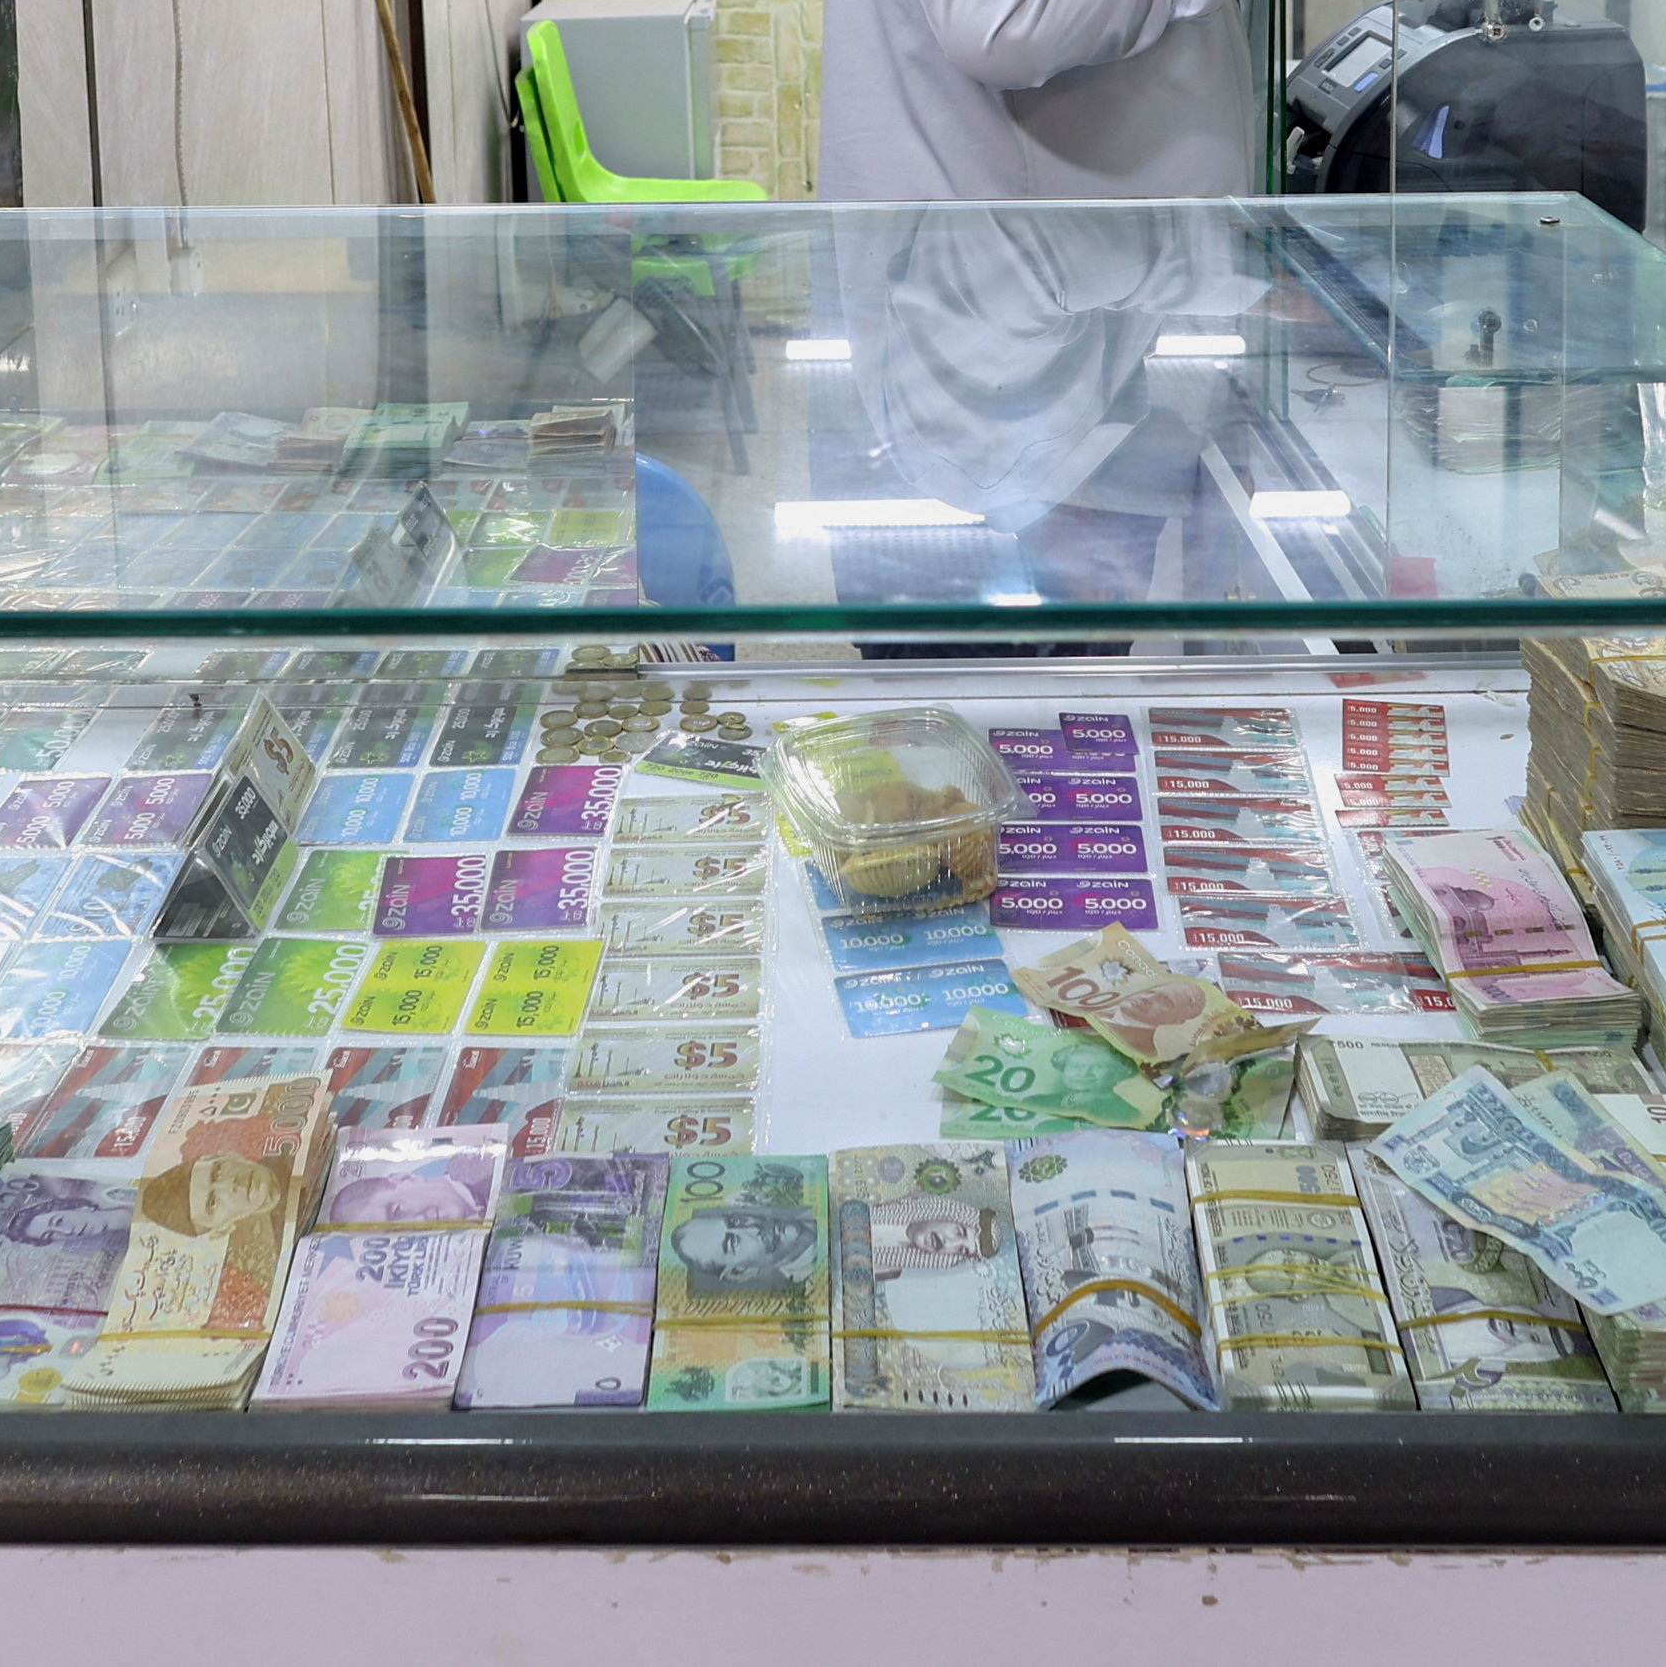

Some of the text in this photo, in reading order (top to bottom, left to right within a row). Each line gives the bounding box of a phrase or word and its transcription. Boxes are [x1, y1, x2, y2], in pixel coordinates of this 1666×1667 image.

[461, 772, 482, 801] 10,000
[1079, 778, 1116, 786] zain
[1075, 793, 1133, 805] 5,000
[450, 806, 472, 837] 10,000
[1082, 826, 1120, 835] zain
[1077, 843, 1137, 856] 5,000
[1090, 880, 1130, 889] zain
[1001, 897, 1064, 910] 5,000
[1084, 897, 1147, 910] 5,000
[413, 944, 443, 981] 15,000
[533, 944, 560, 982] 15,000
[682, 972, 740, 1000] $5
[1046, 965, 1122, 1007] 100
[391, 989, 424, 1027] 15,000
[515, 989, 545, 1028] 15,000
[674, 1040, 738, 1071] $5
[964, 1053, 1037, 1094] 20
[262, 1077, 322, 1157] 5000
[664, 1114, 732, 1149] $5
[680, 1161, 727, 1204] 100
[1296, 1165, 1321, 1193] 500
[355, 1237, 391, 1282] 200
[402, 1315, 464, 1385] 200
